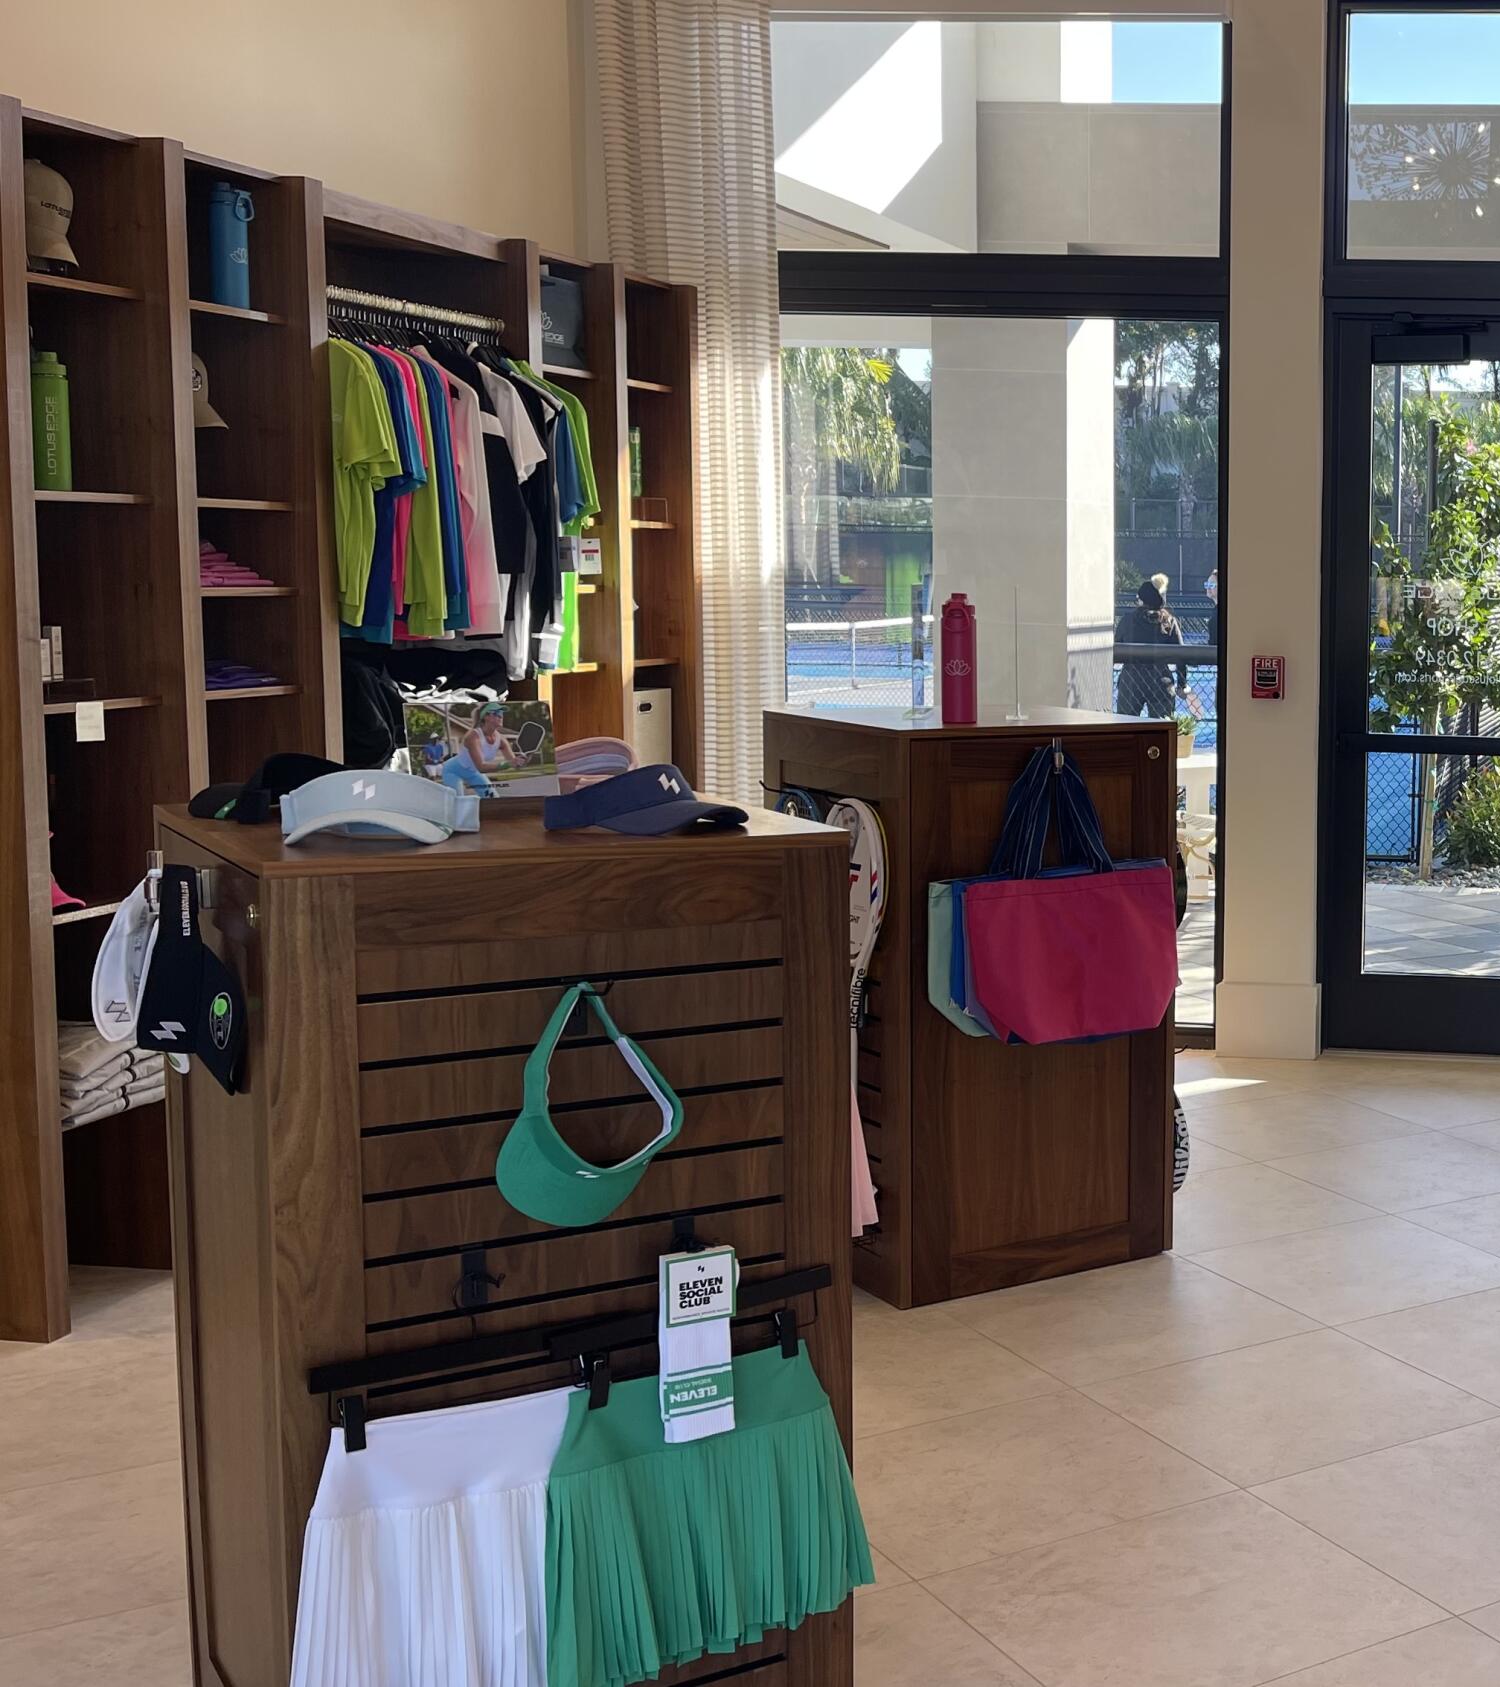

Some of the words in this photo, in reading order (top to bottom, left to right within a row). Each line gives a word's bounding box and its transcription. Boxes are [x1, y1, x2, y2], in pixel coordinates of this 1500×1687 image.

[45, 396, 56, 431] EDGE
[47, 431, 57, 476] LOTUS
[1254, 658, 1278, 668] FIRE
[678, 1276, 723, 1292] ELEVEN
[679, 1286, 724, 1300] SOCIAL
[679, 1296, 710, 1310] CLUB
[669, 1385, 718, 1404] ELEVEN
